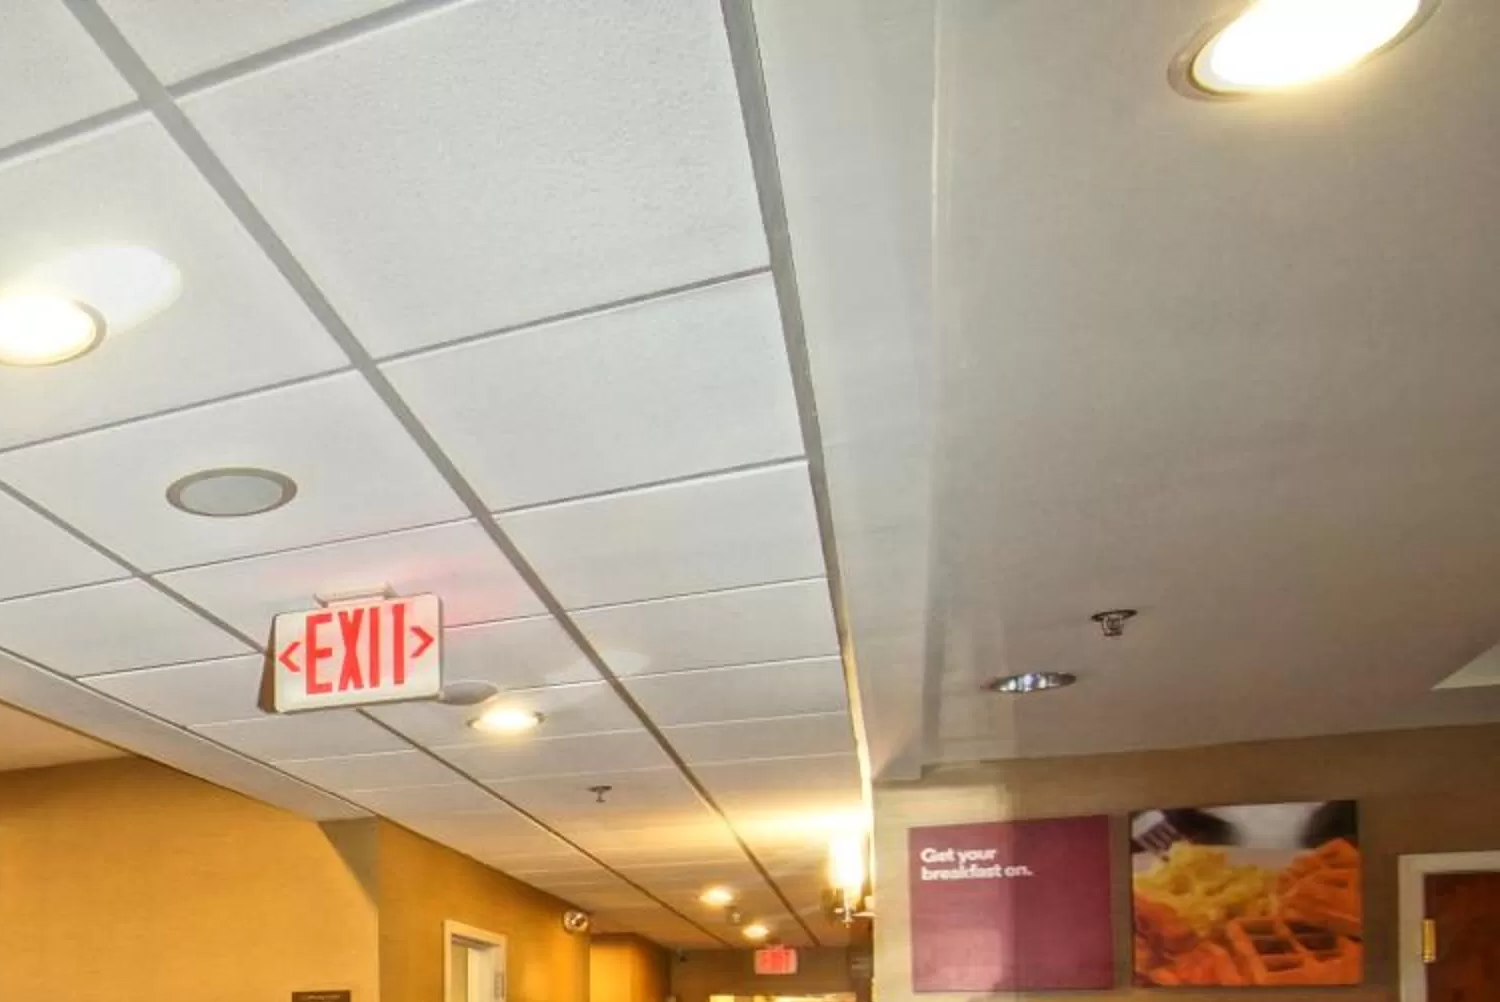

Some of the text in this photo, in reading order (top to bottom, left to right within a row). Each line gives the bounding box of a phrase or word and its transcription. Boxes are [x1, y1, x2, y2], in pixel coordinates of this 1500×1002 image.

[306, 603, 407, 694] EXIT
[921, 848, 997, 870] Get your
[921, 864, 1001, 880] breakfast
